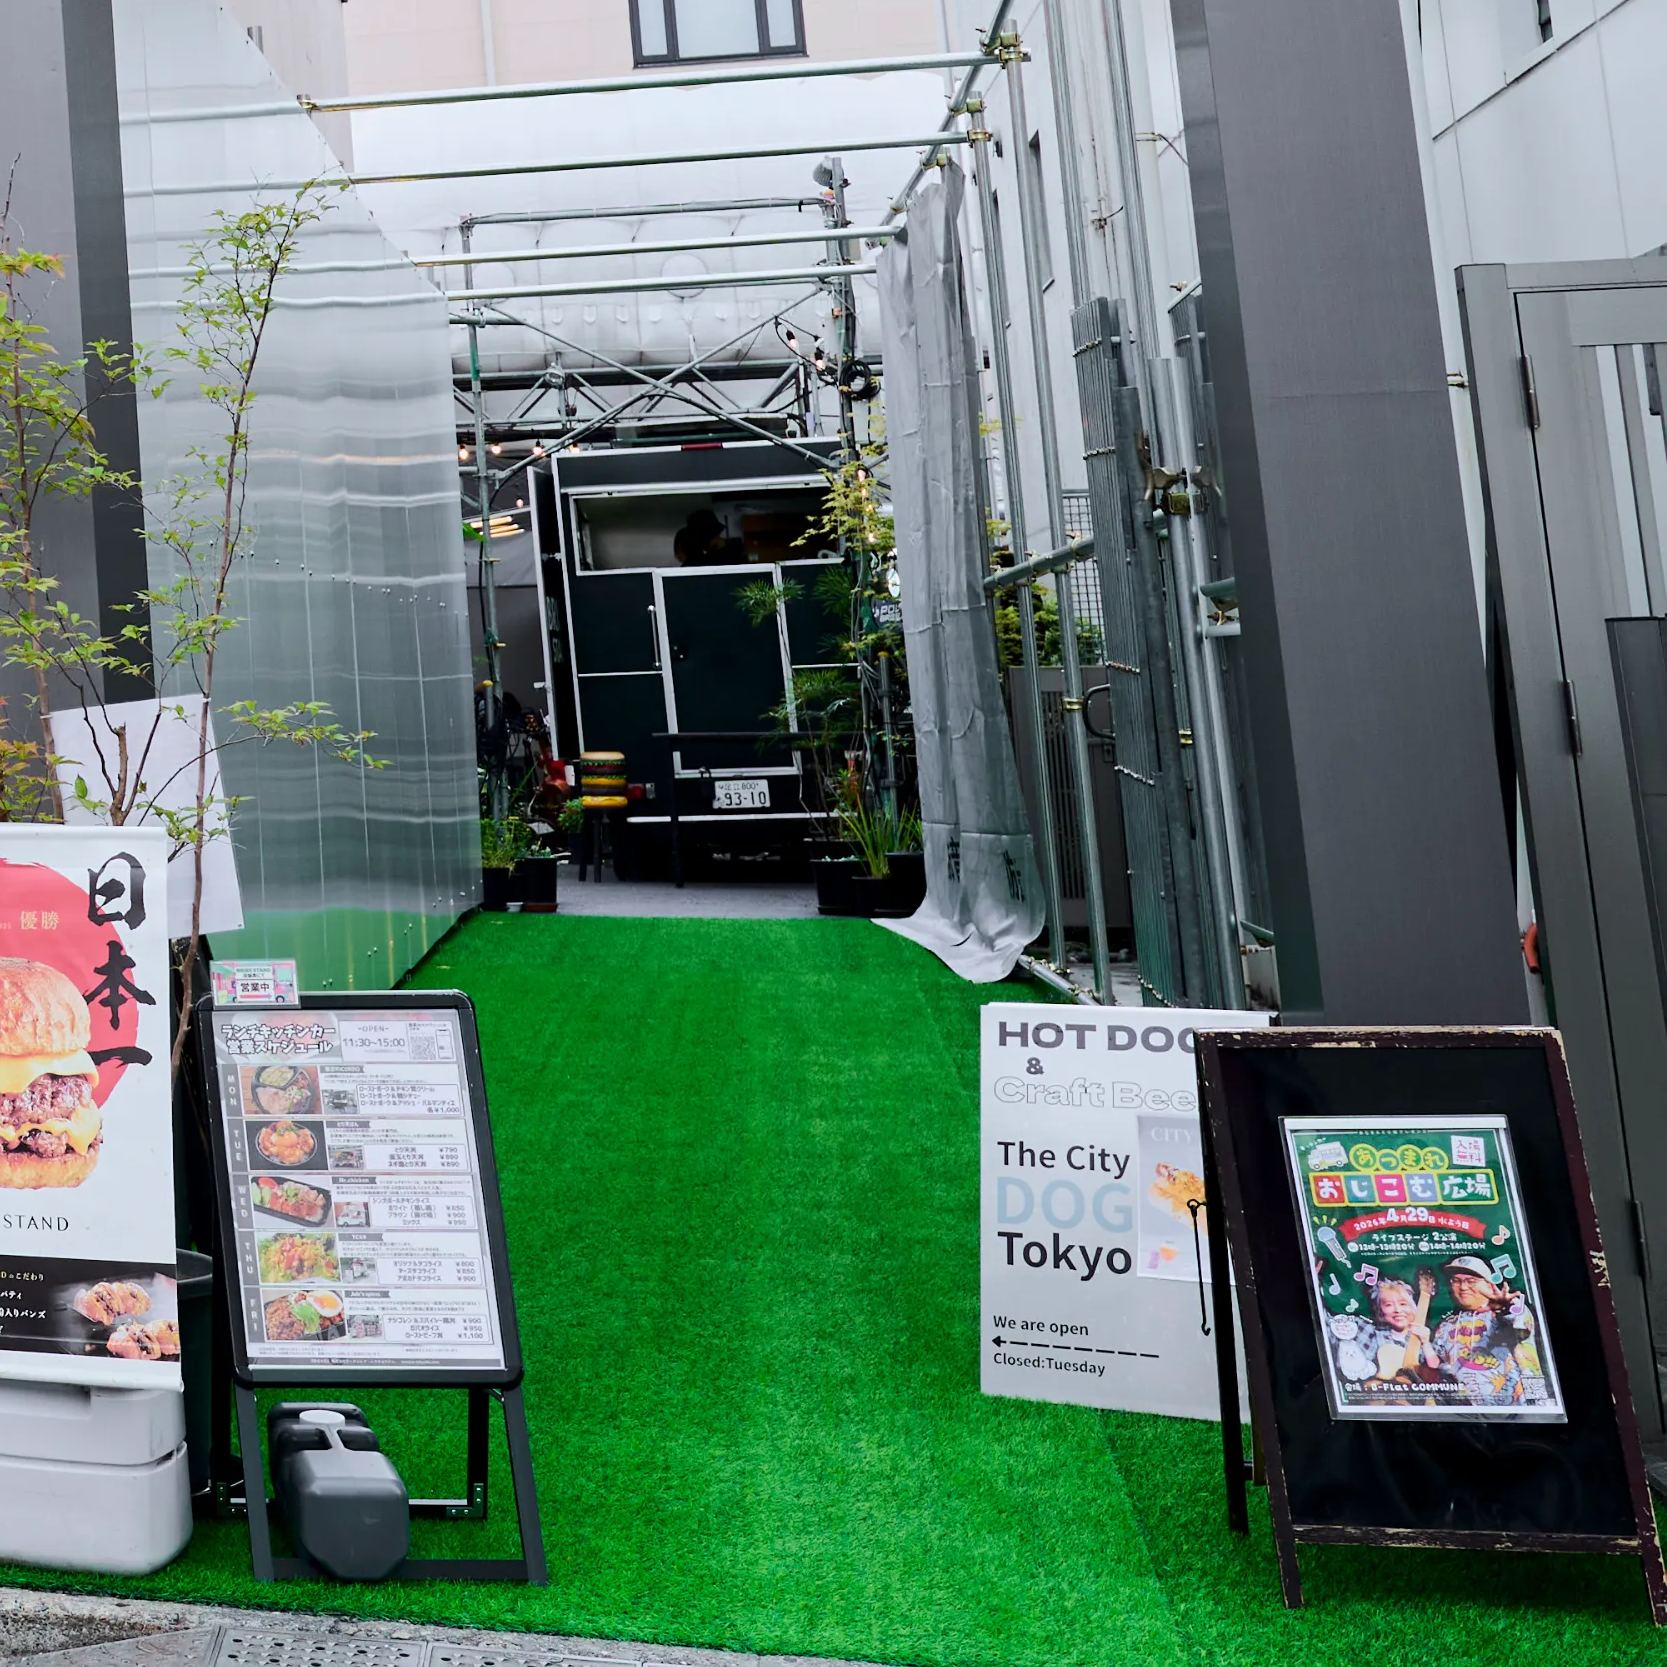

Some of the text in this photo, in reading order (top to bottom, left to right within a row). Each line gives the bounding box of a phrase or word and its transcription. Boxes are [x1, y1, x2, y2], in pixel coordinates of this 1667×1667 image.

[724, 791, 766, 806] 93-10
[20, 910, 59, 930] 優勝
[83, 851, 157, 1069] 日本一
[240, 983, 269, 993] 営業中
[221, 1024, 336, 1039] ランチキッチンカー
[998, 1021, 1096, 1050] HOT
[226, 1039, 334, 1054] 営業スケジュール
[1025, 1057, 1044, 1075] &
[227, 1074, 237, 1106] MON
[993, 1075, 1197, 1112] Craft Bee
[233, 1129, 242, 1162] TUE
[1151, 1127, 1195, 1142] CITY
[997, 1141, 1130, 1179] The City
[1355, 1149, 1444, 1169] あつまれ
[1456, 1152, 1482, 1163] 無料
[1318, 1173, 1492, 1199] おじこむ広場
[238, 1185, 248, 1218] WED
[996, 1177, 1133, 1232] DOG
[3, 1214, 69, 1232] STAND
[1354, 1207, 1469, 1231] 2026年4月29日 水よう日
[245, 1242, 254, 1274] THU
[998, 1231, 1132, 1281] Tokyo
[250, 1298, 258, 1331] FRI
[993, 1315, 1089, 1337] We are open
[993, 1352, 1105, 1377] Closed:Tuesday
[1411, 1383, 1465, 1392] COMMUNE
